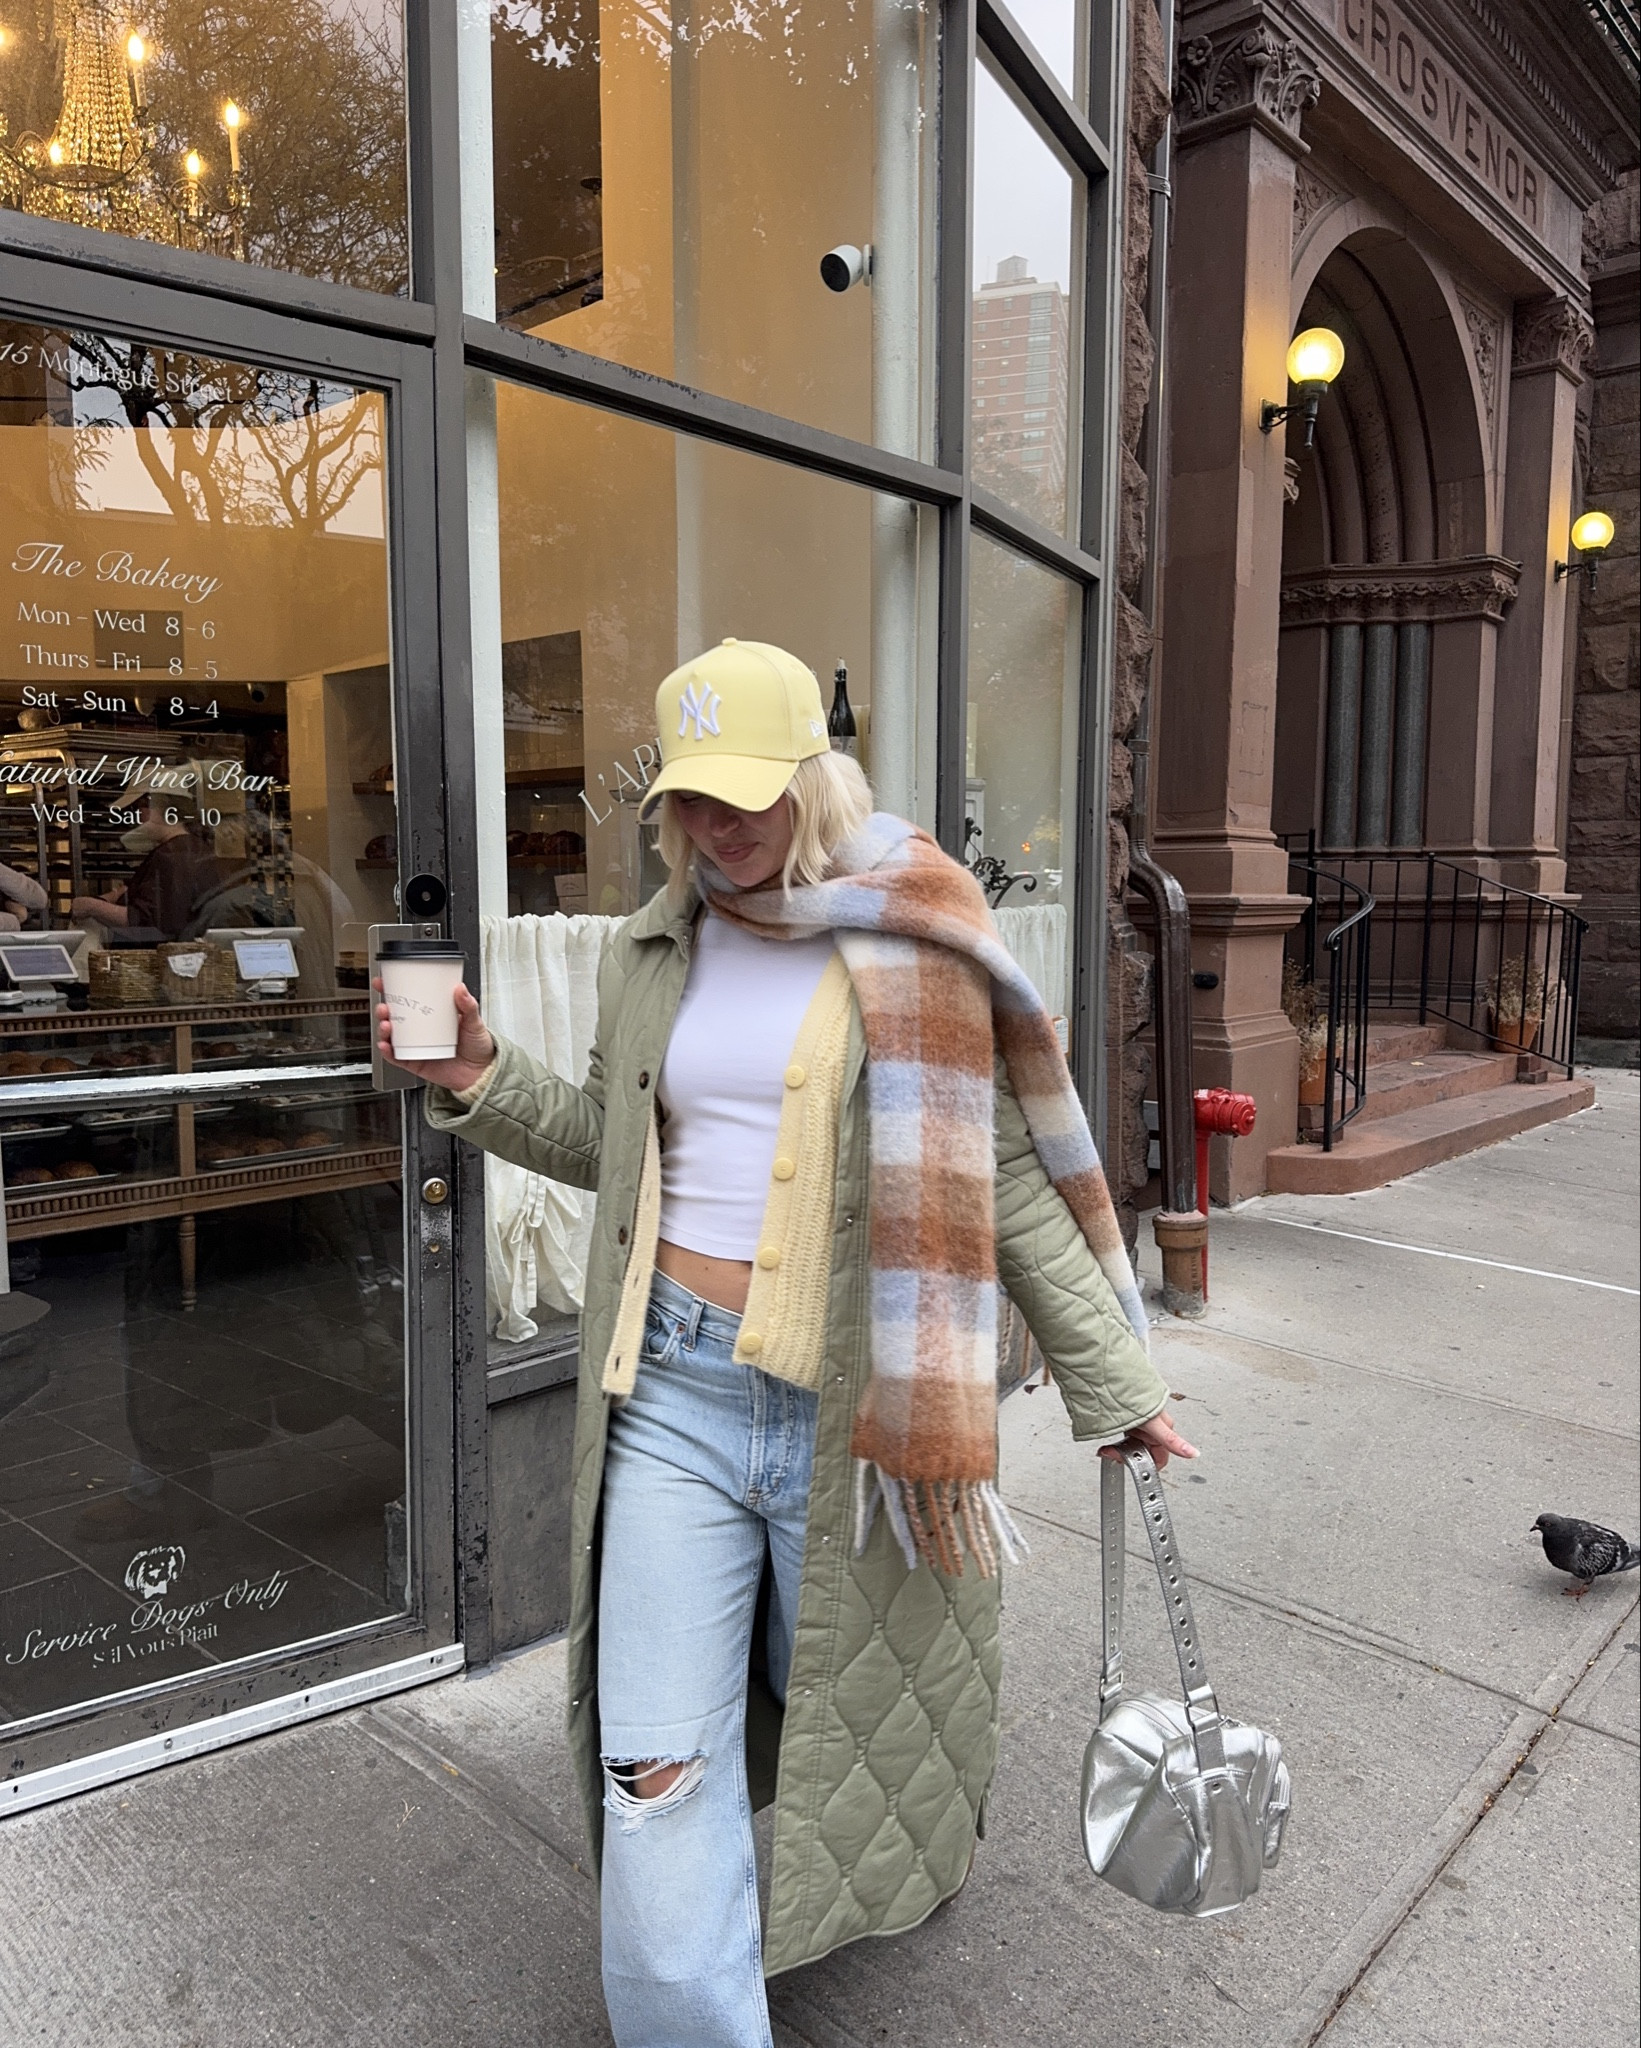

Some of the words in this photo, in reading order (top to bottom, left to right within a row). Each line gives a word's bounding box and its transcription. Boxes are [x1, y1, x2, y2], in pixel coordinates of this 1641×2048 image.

[1343, 0, 1537, 225] GROSVENOR
[38, 347, 160, 391] Montague
[165, 371, 234, 404] Street
[11, 542, 87, 578] The
[96, 550, 223, 604] Bakery
[18, 602, 71, 626] Mon
[94, 609, 146, 633] Wed
[165, 616, 180, 637] 8
[202, 620, 216, 640] 6
[20, 643, 89, 669] Thurs
[112, 652, 141, 673] Fri
[168, 657, 183, 677] 8
[205, 660, 218, 680] 5
[21, 685, 59, 708] Sat
[82, 690, 127, 713] Sun
[169, 696, 184, 716] 8
[205, 699, 219, 719] 4
[677, 681, 722, 741] NY
[116, 756, 202, 789] Wine
[207, 759, 278, 792] Bar
[30, 803, 84, 824] Wed
[108, 805, 142, 825] Sat
[165, 806, 178, 826] 6
[200, 807, 221, 827] 10
[5, 1623, 118, 1665] Service
[130, 1598, 212, 1635] Dogs
[225, 1570, 288, 1611] Only
